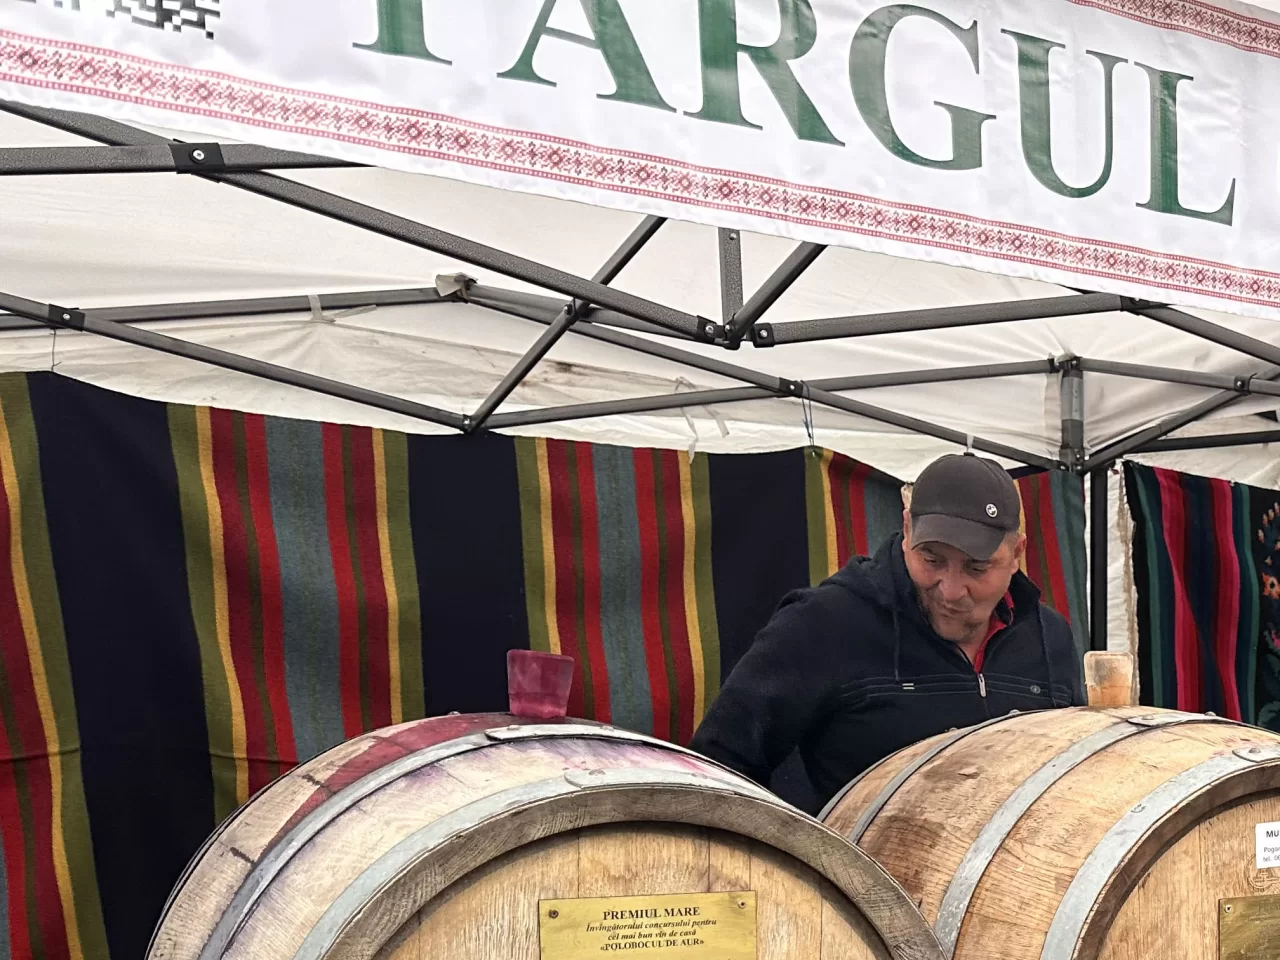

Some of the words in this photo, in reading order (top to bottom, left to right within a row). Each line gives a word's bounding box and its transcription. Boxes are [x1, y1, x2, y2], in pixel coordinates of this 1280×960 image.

[603, 908, 661, 920] PREMIUL
[664, 906, 700, 917] MARE
[692, 919, 717, 928] pentru
[621, 931, 636, 940] mai
[638, 931, 652, 939] bun
[669, 929, 678, 937] de
[666, 939, 678, 947] DE
